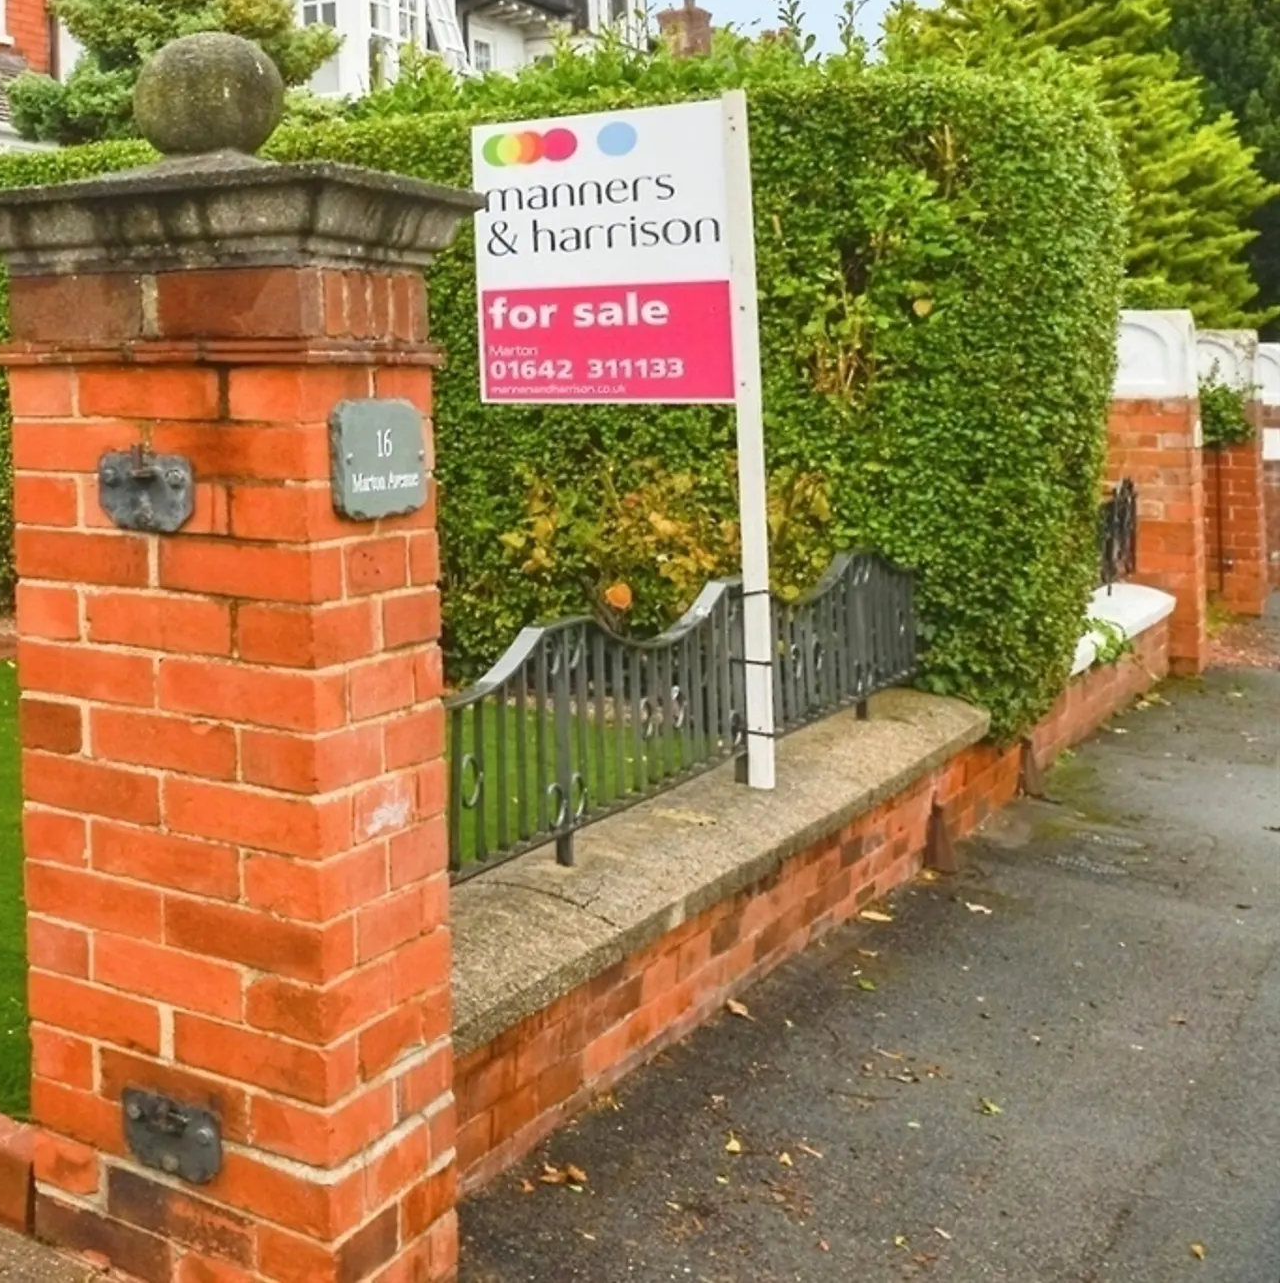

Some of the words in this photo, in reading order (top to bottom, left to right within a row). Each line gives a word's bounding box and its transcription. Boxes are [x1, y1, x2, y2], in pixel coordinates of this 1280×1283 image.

[484, 173, 675, 213] manners
[486, 220, 518, 257] &
[533, 216, 721, 253] harrison
[488, 297, 557, 330] for
[573, 292, 670, 328] sale
[489, 345, 538, 357] Marton
[490, 359, 574, 380] 01642
[587, 358, 685, 379] 311133
[376, 428, 393, 458] 16
